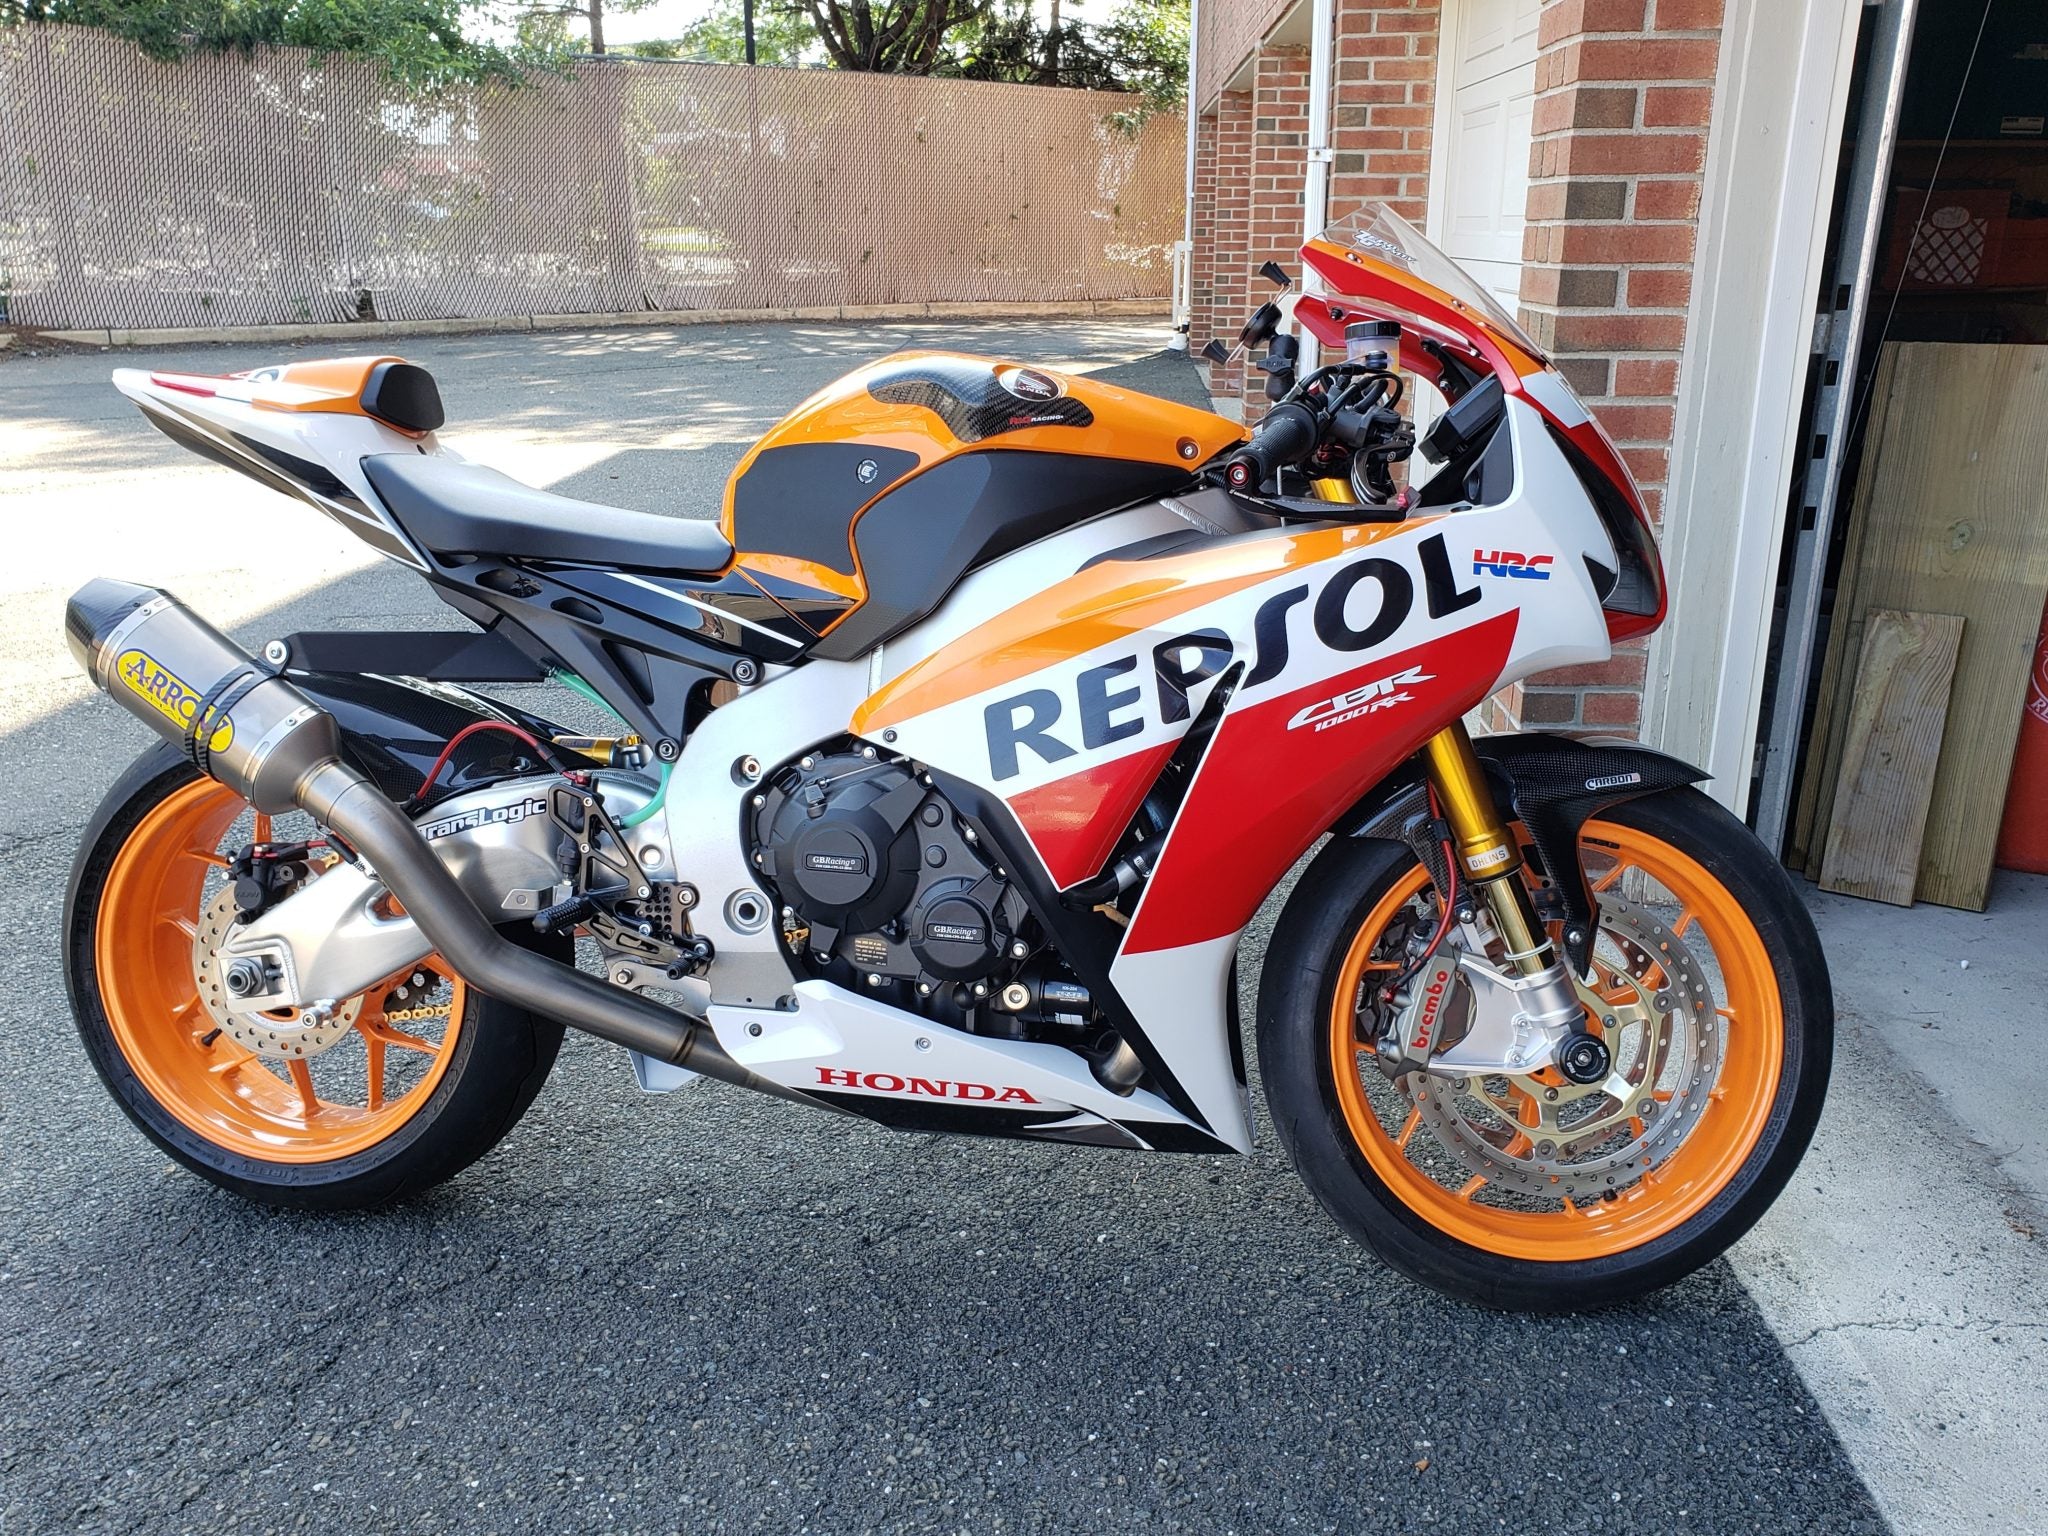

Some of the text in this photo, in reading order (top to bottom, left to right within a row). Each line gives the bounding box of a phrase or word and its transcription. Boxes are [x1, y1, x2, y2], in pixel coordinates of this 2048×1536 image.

[1473, 549, 1553, 580] HRC
[984, 532, 1482, 782] REPSOL
[1287, 665, 1437, 731] CBR
[1314, 692, 1416, 732] 1000RR
[933, 925, 972, 936] GBRacing
[1411, 970, 1448, 1049] brembo
[815, 1066, 1043, 1105] HONDA
